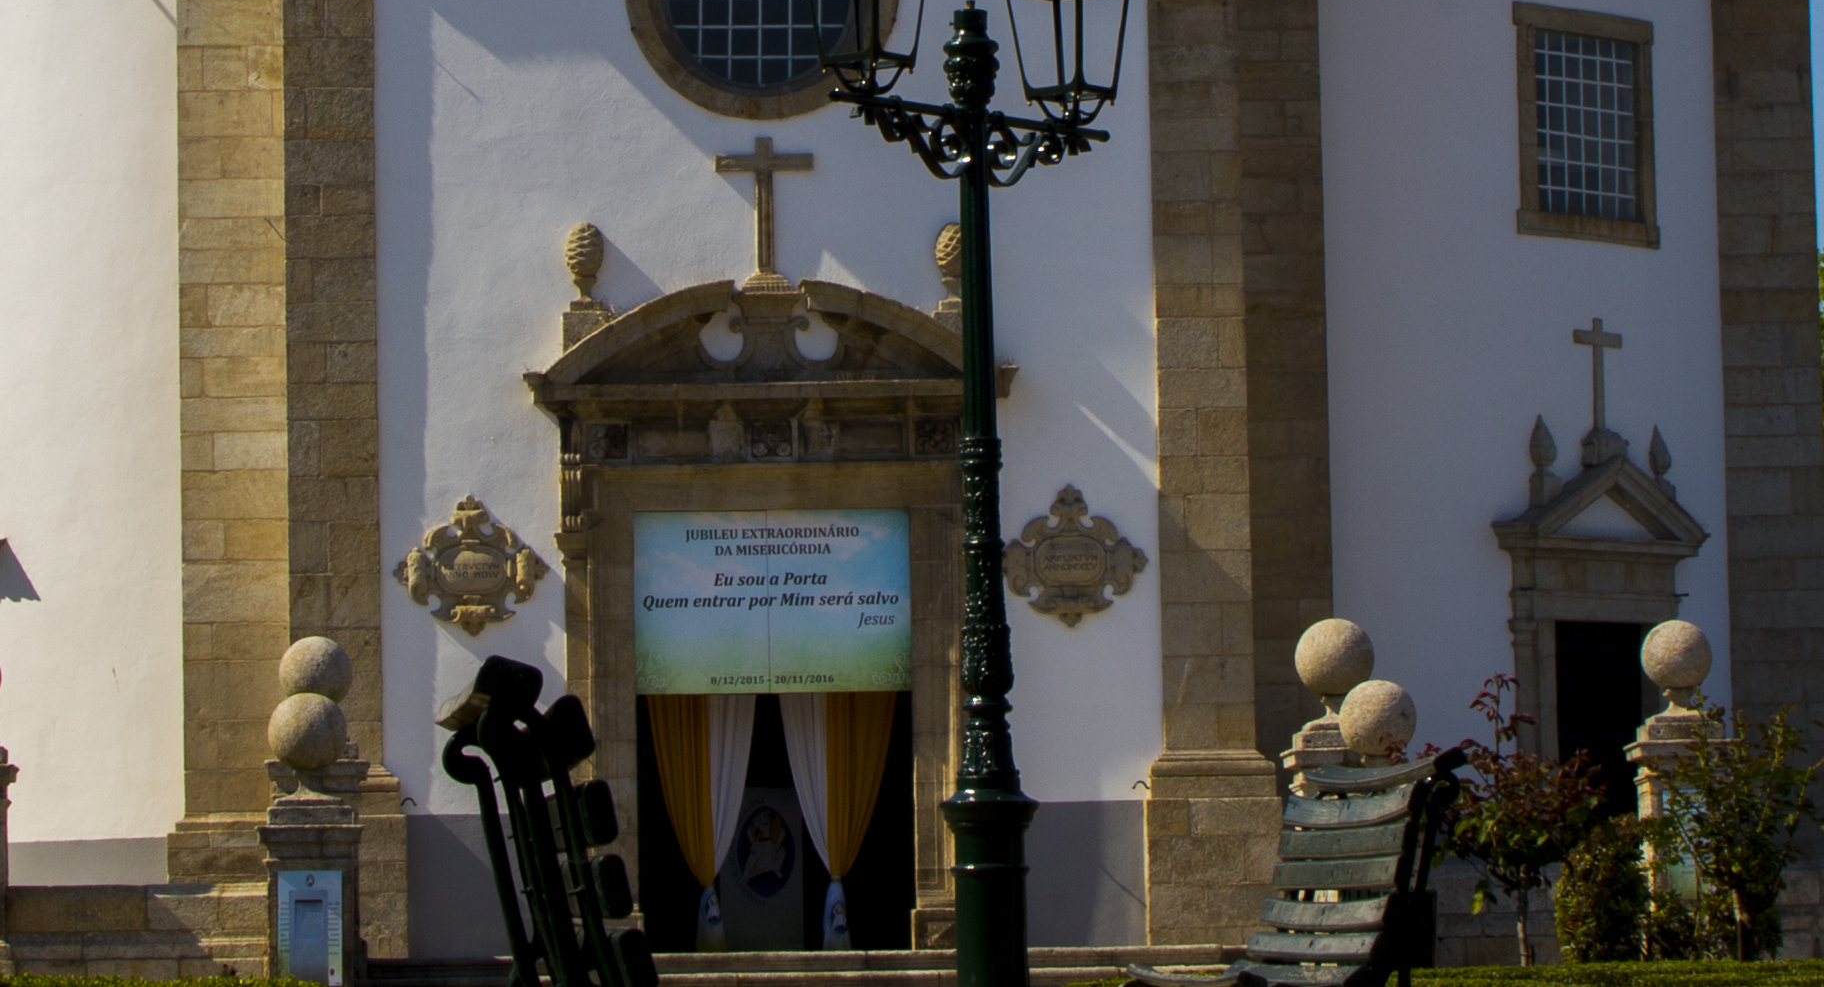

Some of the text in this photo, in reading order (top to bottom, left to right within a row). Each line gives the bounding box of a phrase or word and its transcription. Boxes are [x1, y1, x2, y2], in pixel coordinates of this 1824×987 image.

[685, 525, 860, 543] JUBILEU EXTRAORDINÁRIO
[715, 542, 832, 556] DA MISERICÓRDIA
[714, 572, 827, 586] Eu sou a Porta
[643, 591, 899, 611] Quem entrar por Mim será salvo
[857, 612, 895, 628] Jesus
[710, 675, 764, 686] 8/12/2015
[774, 674, 835, 685] 20/11/2016
